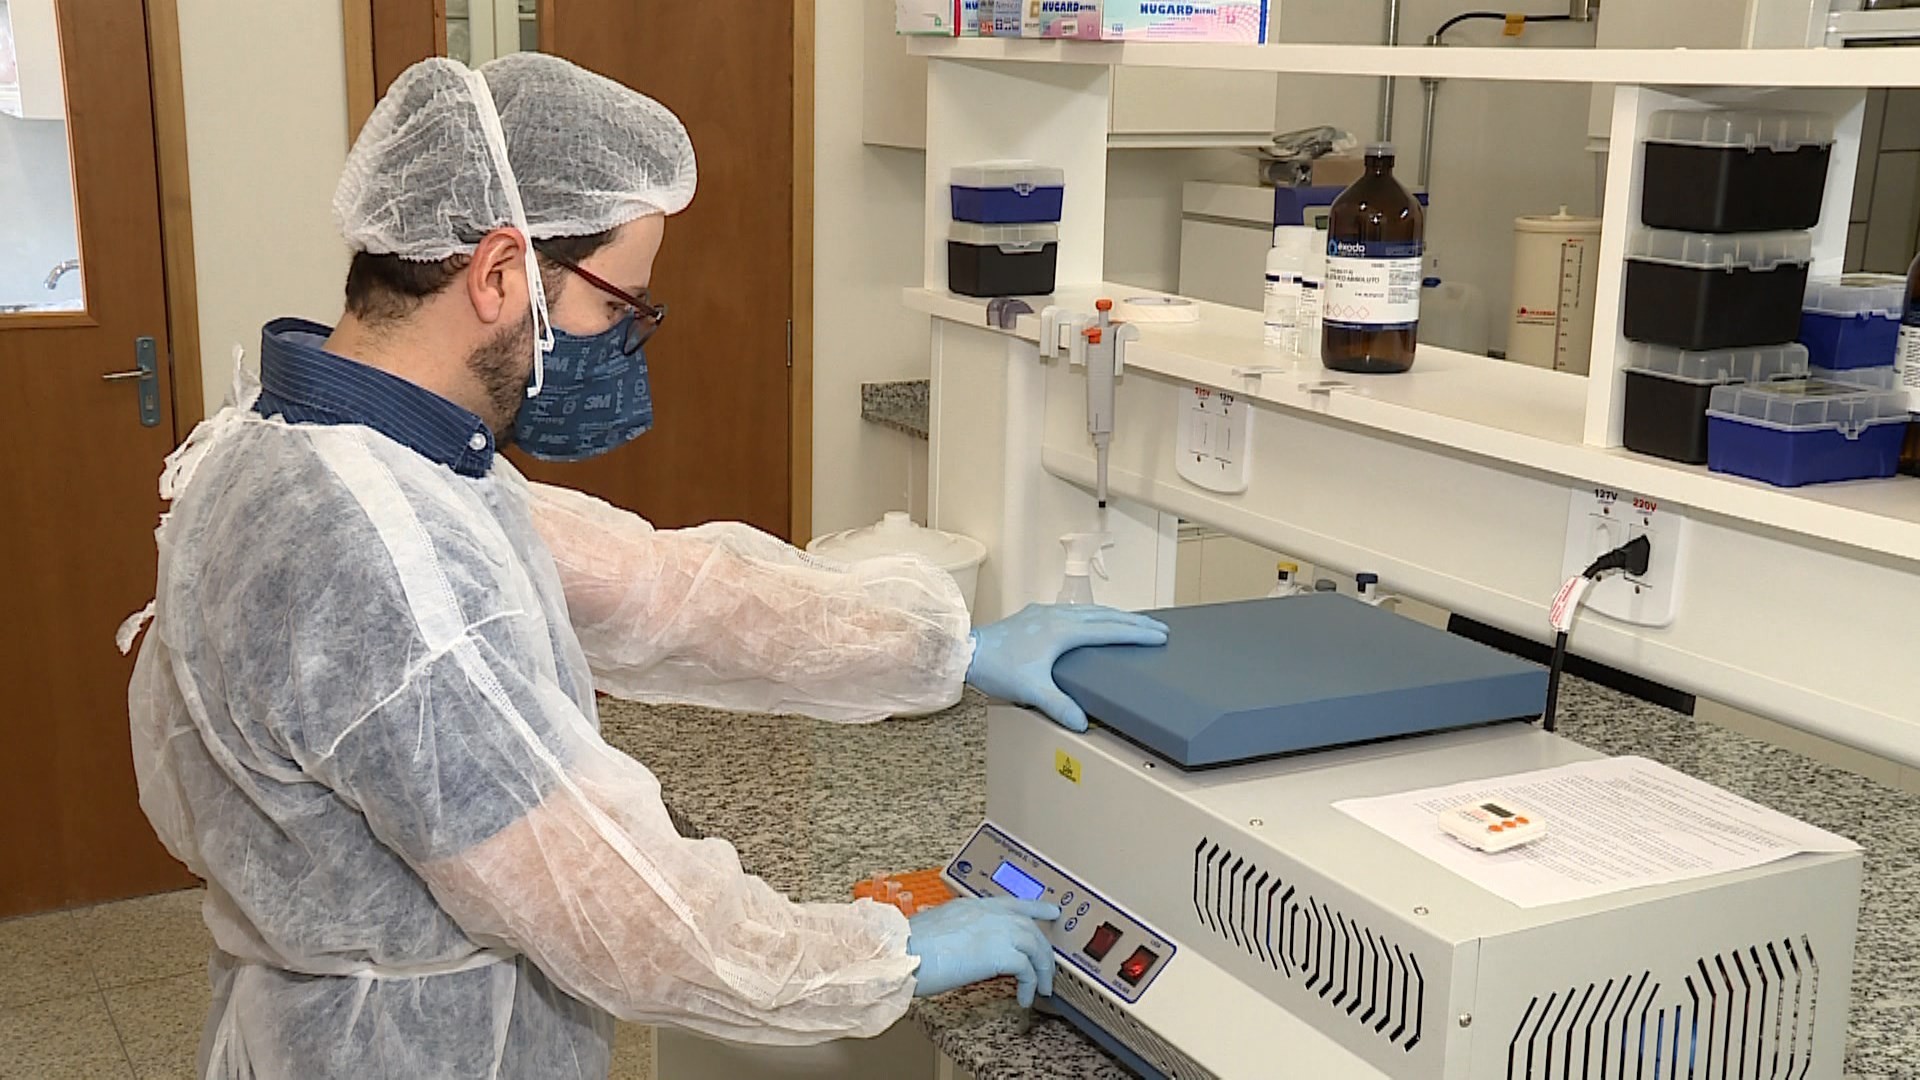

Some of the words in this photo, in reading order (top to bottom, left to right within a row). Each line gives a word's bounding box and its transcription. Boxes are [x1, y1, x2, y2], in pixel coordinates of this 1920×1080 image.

[1042, 1, 1079, 12] NUGARD
[1140, 4, 1194, 15] NUGARD
[584, 394, 612, 410] 3M
[1594, 489, 1618, 500] 127V
[1633, 498, 1657, 511] 220V
